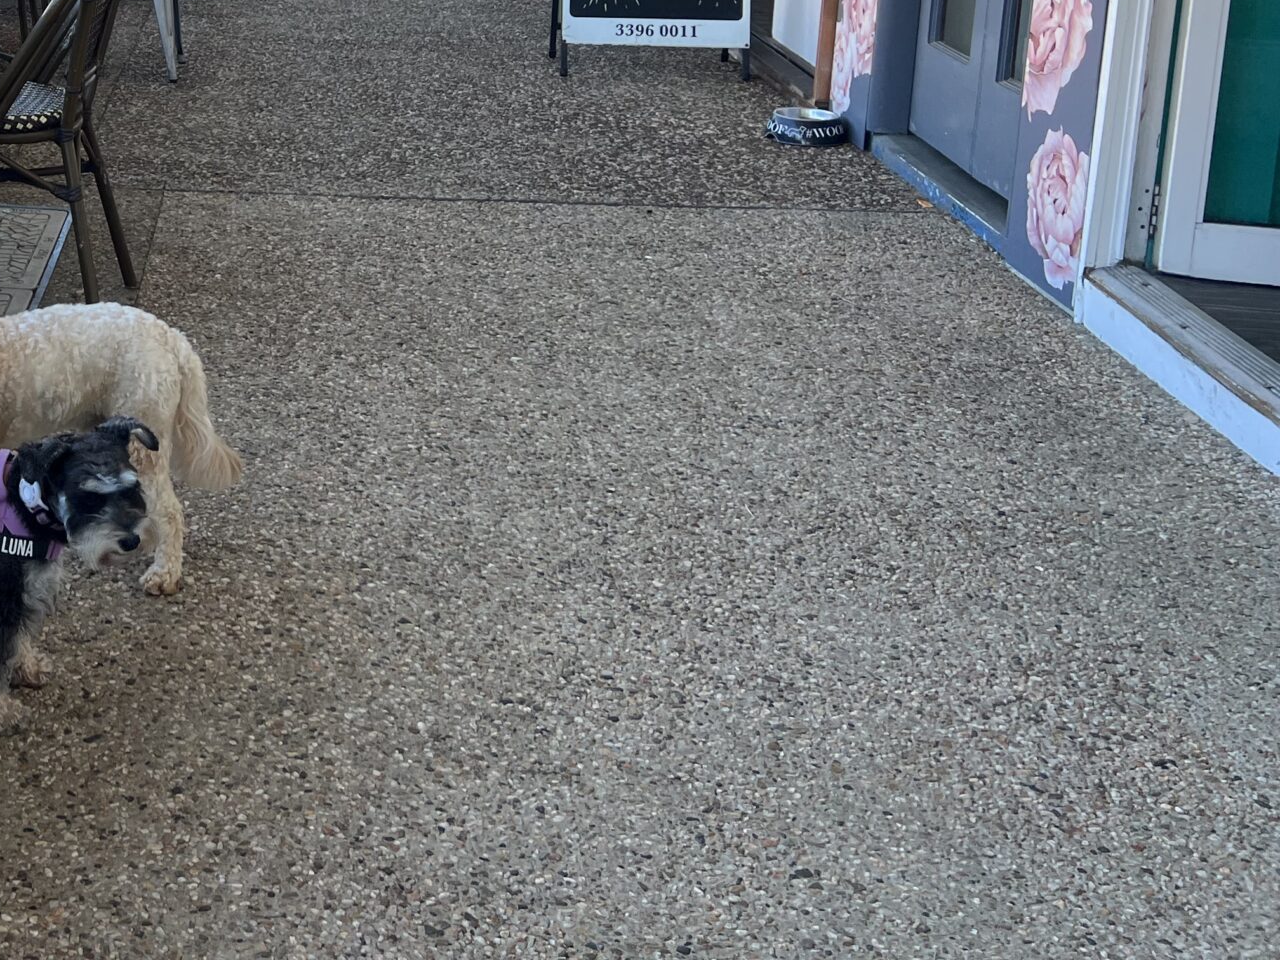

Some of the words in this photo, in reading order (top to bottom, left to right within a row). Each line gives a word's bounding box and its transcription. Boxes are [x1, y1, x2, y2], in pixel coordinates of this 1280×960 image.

[615, 23, 655, 38] 3396
[659, 24, 697, 38] 0011
[1, 536, 34, 557] LUNA
